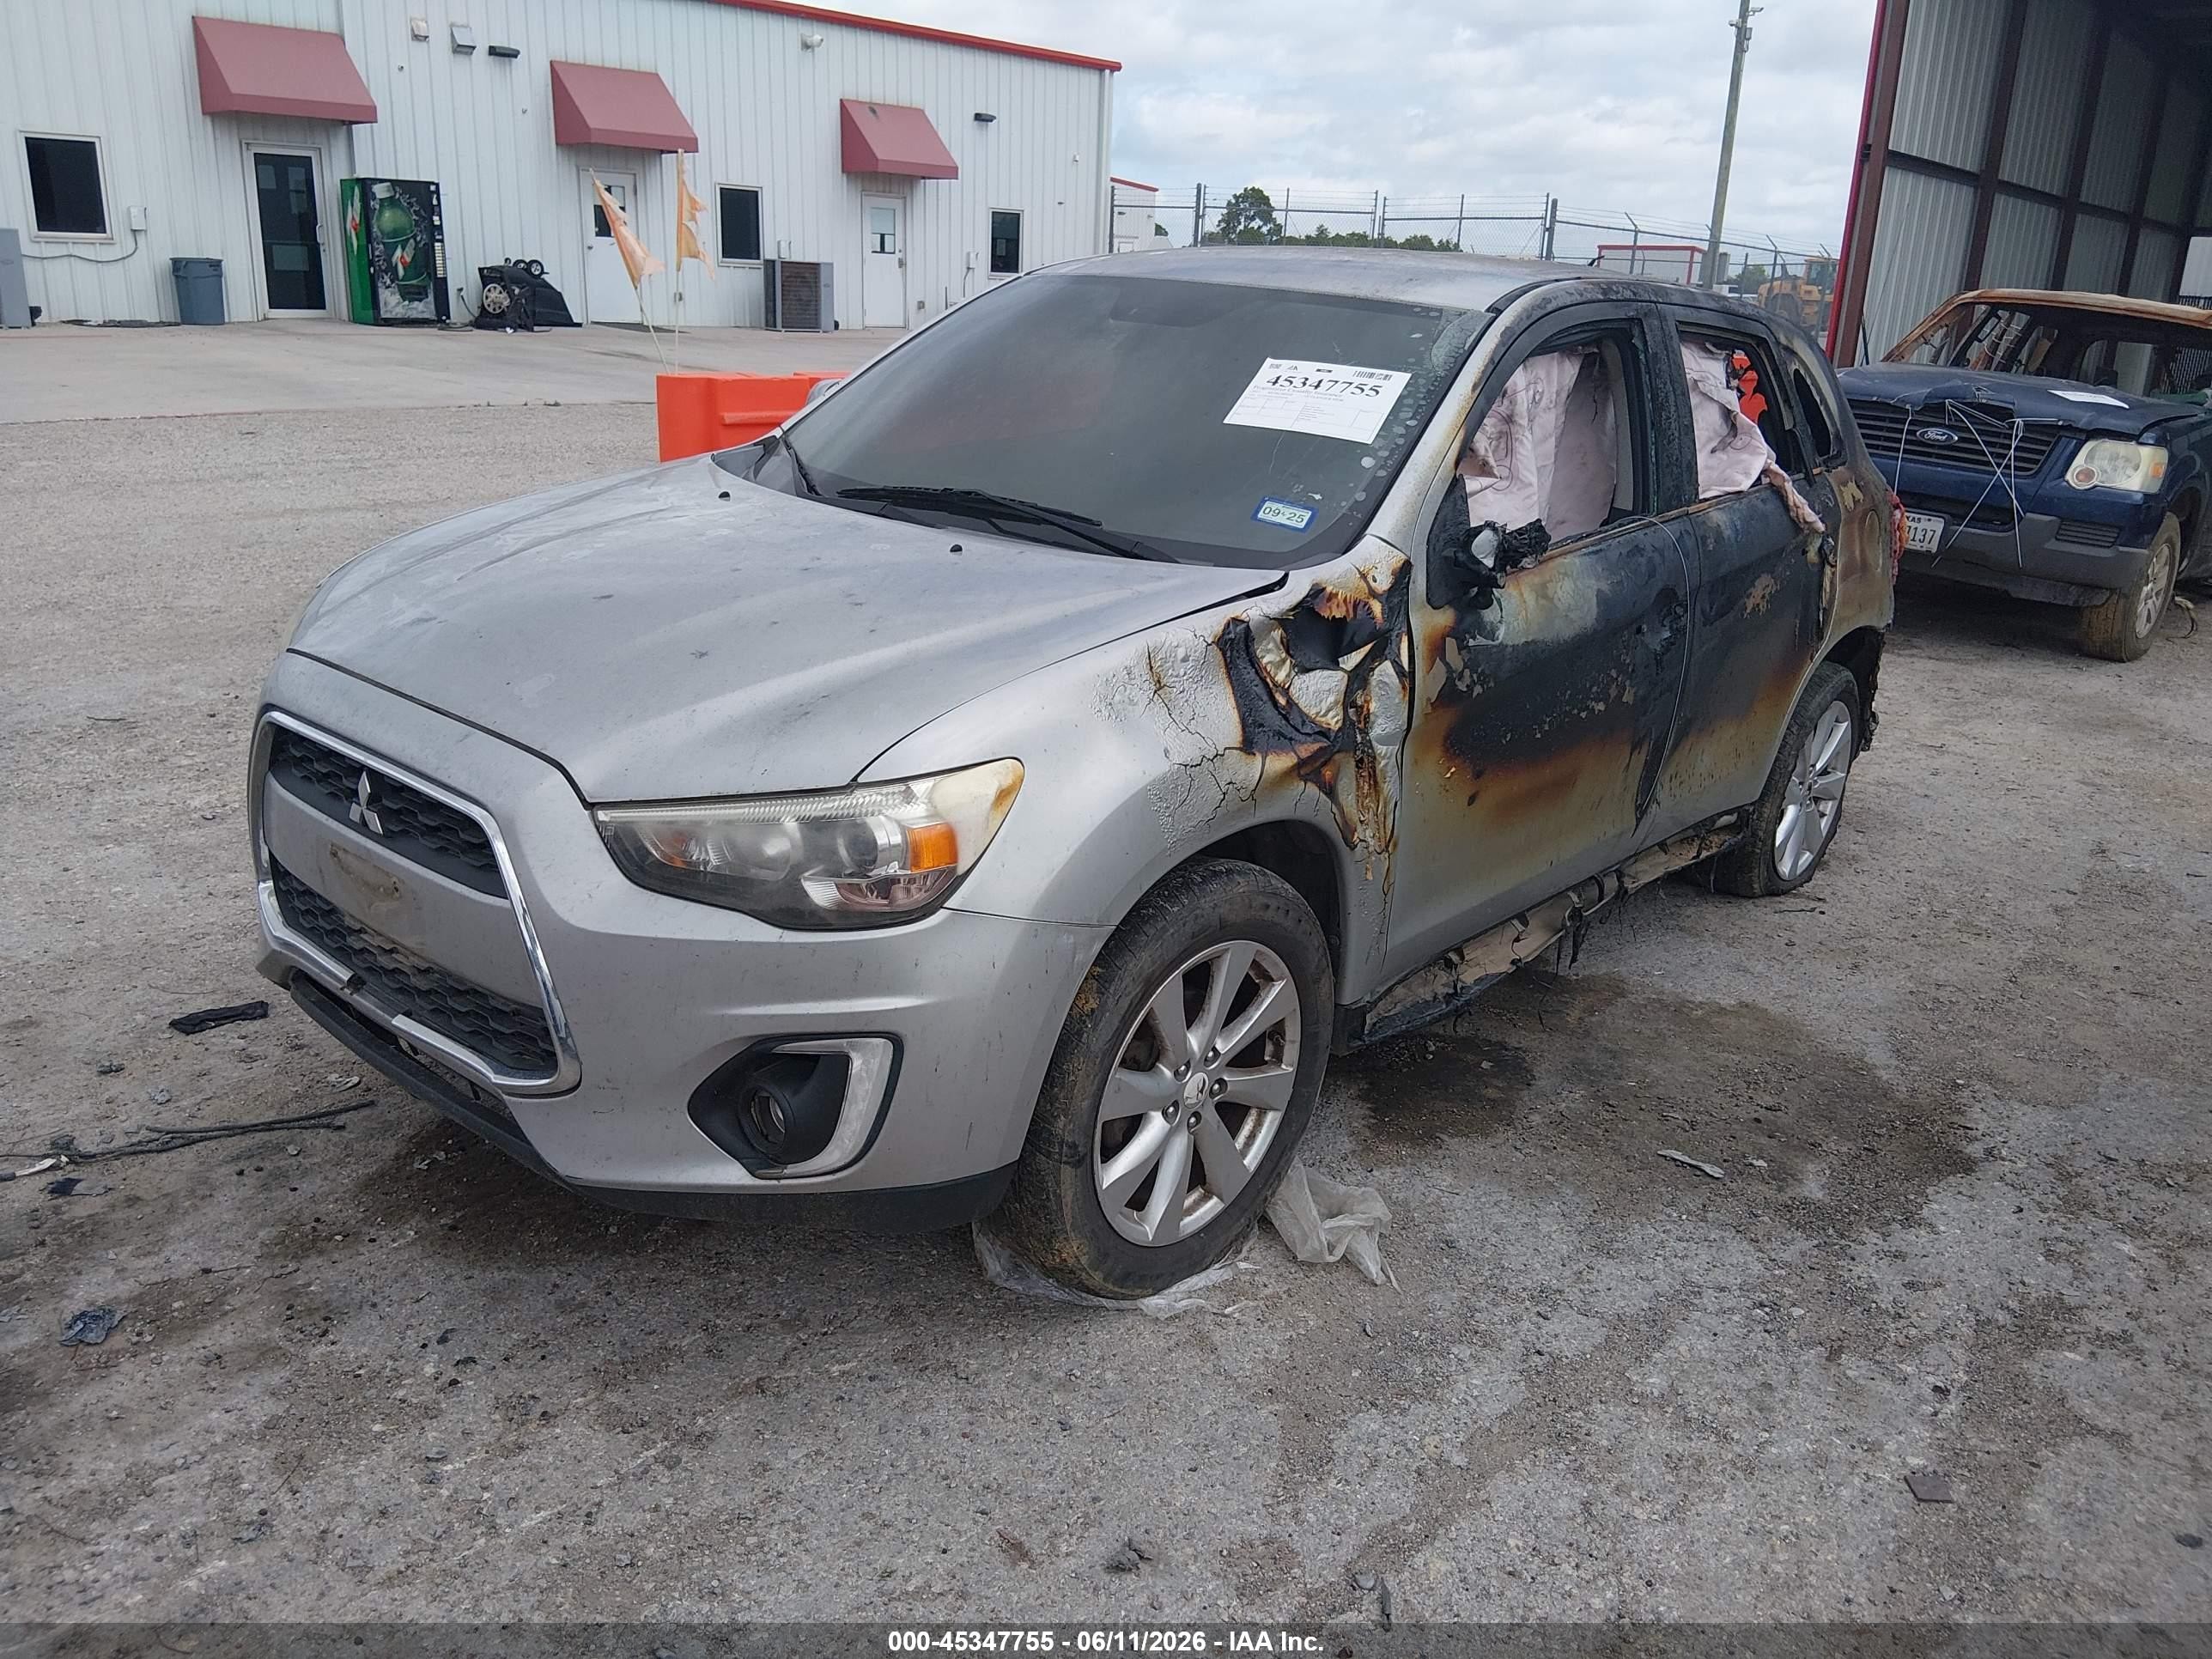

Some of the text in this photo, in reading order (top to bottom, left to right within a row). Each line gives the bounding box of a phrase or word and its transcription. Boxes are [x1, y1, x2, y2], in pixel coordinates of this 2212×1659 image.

[1267, 374, 1383, 398] 45347755
[1923, 430, 1948, 441] Ford
[1262, 506, 1306, 524] 09 25
[1905, 515, 1922, 524] XAS
